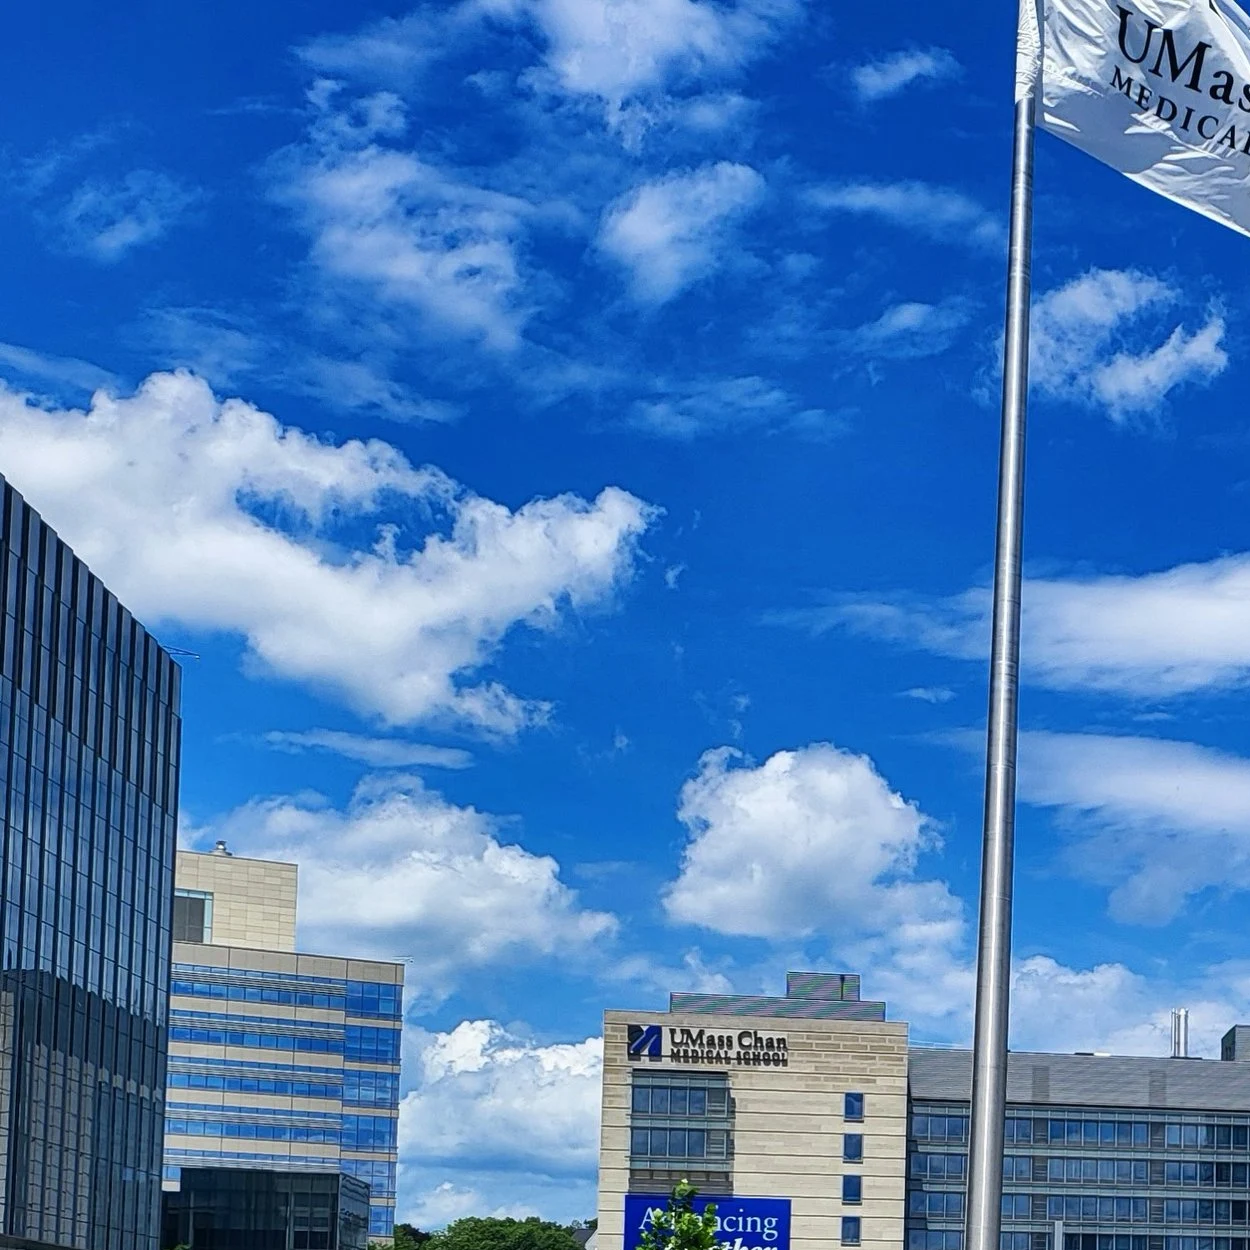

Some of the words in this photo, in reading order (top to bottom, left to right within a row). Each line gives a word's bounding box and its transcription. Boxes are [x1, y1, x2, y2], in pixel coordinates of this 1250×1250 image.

[669, 1028, 733, 1048] UMass
[738, 1031, 788, 1051] Chan
[670, 1048, 731, 1063] MEDICAL
[736, 1051, 788, 1066] SCHOOL
